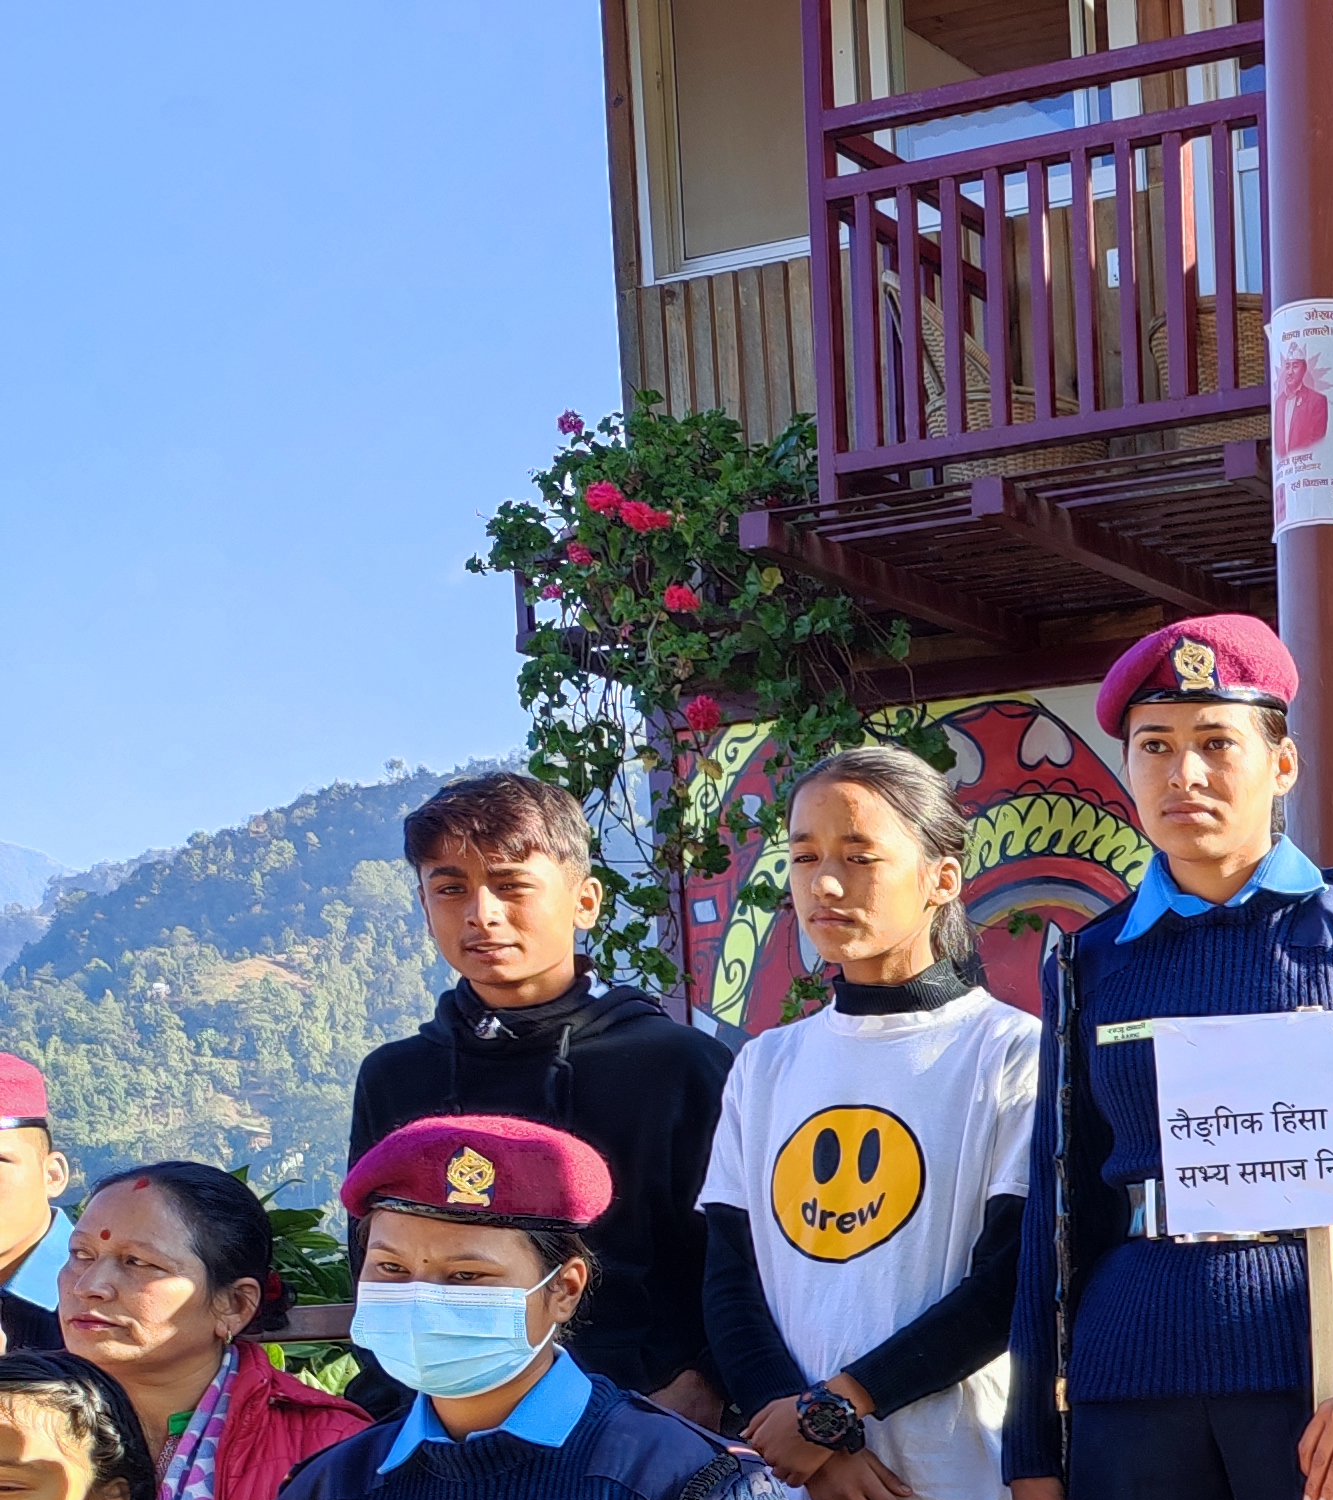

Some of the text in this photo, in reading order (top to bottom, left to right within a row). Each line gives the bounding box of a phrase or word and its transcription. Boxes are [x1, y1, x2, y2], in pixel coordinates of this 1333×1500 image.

[1269, 1101, 1329, 1131] हिंसा
[1174, 1163, 1232, 1189] सभ्य
[1235, 1158, 1309, 1184] समाज
[801, 1191, 887, 1235] drew
